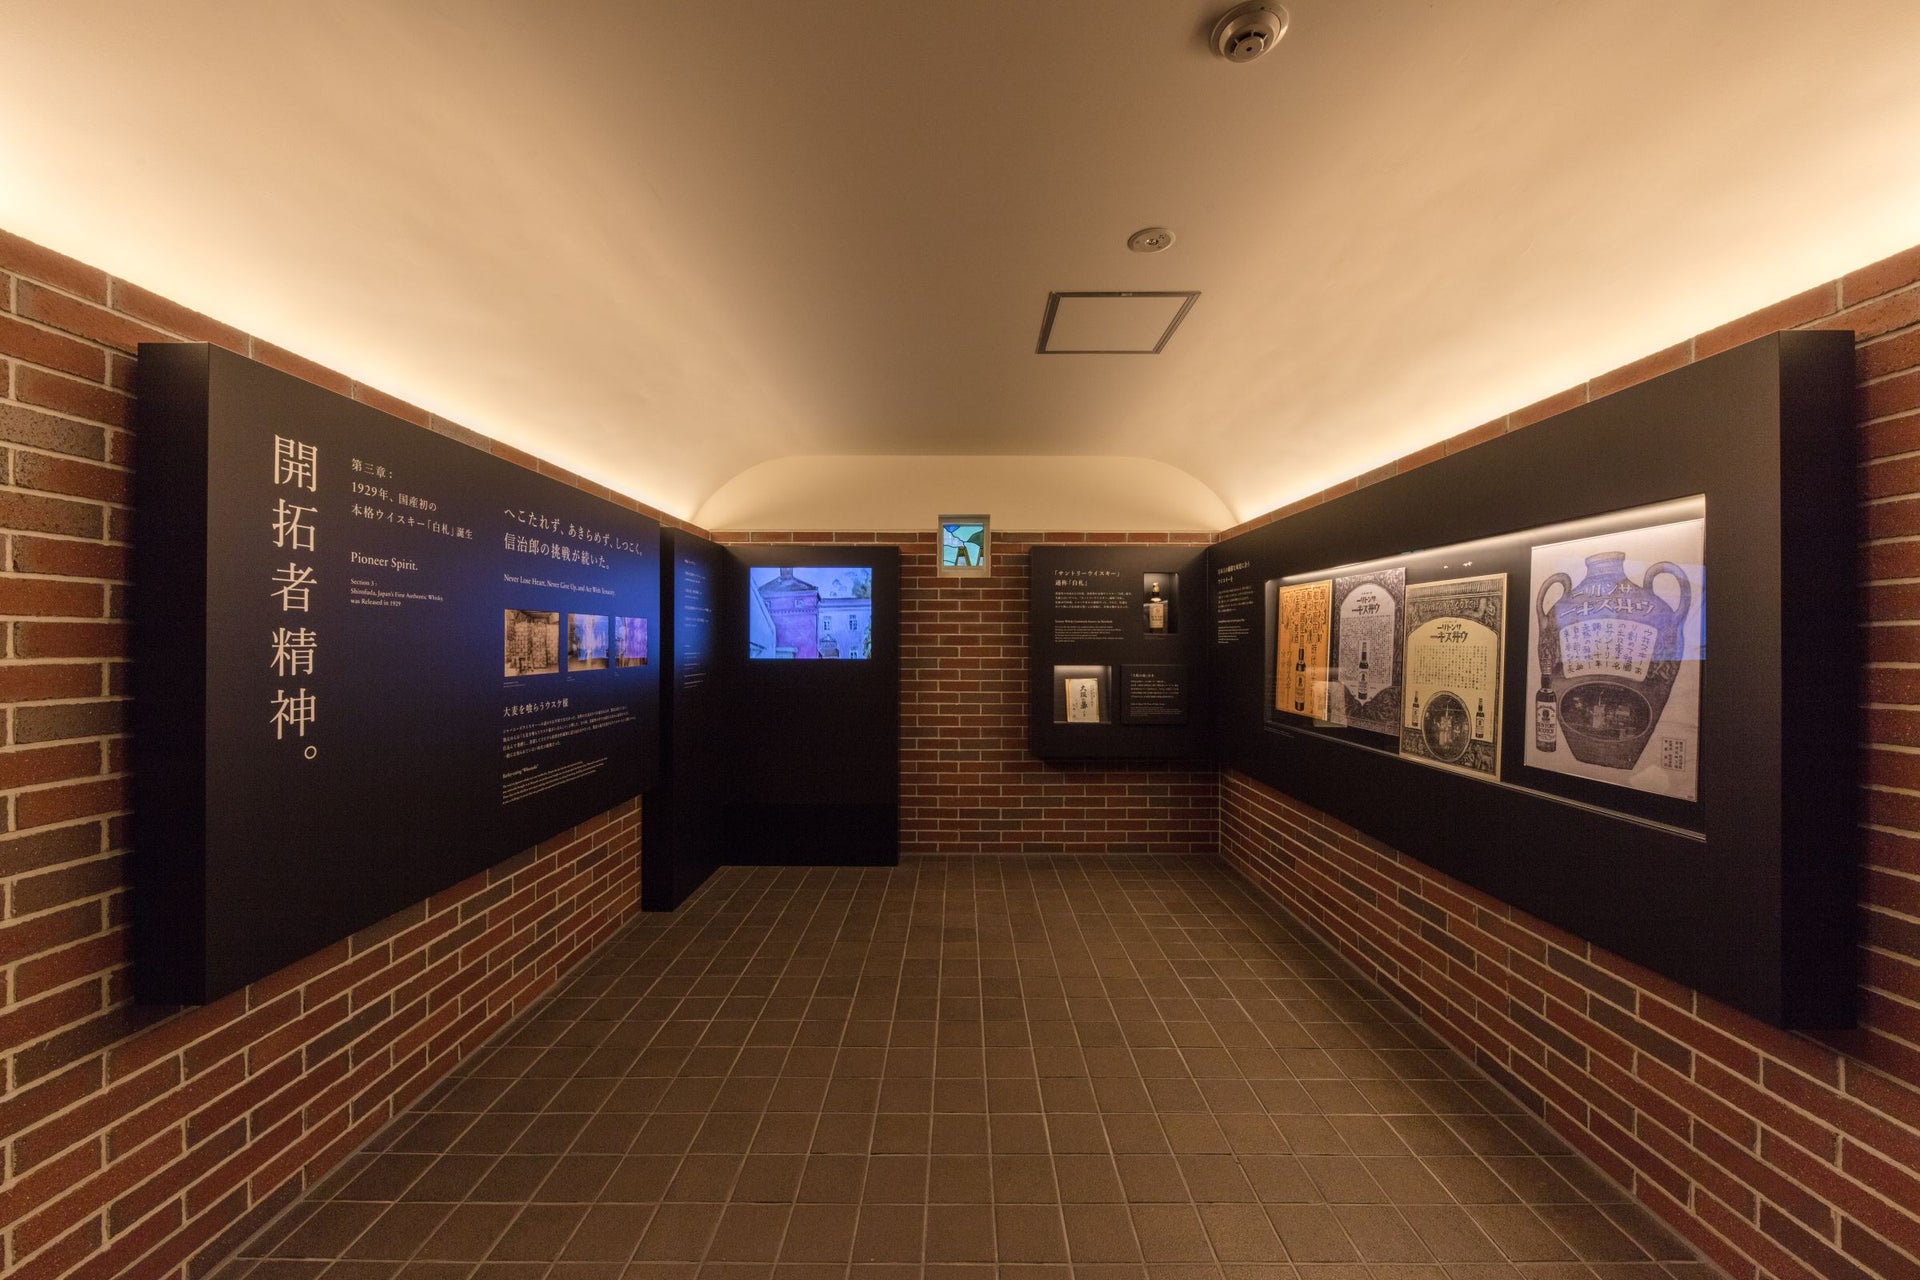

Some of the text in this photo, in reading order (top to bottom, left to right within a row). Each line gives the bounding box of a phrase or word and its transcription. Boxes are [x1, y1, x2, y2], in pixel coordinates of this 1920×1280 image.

[351, 481, 437, 512] 1929年、国産初の
[351, 503, 473, 540] 本格ウイスキー「白札」誕生
[504, 508, 643, 557] へこたれず、あきらめず、しつこく。
[351, 551, 419, 572] Pioneer Spirit.
[503, 532, 611, 570] 信治郎の挑戦が続いた。
[503, 573, 519, 583] Never
[520, 576, 531, 585] Lose
[270, 433, 319, 760] 開拓者精神。
[361, 598, 383, 606] Released
